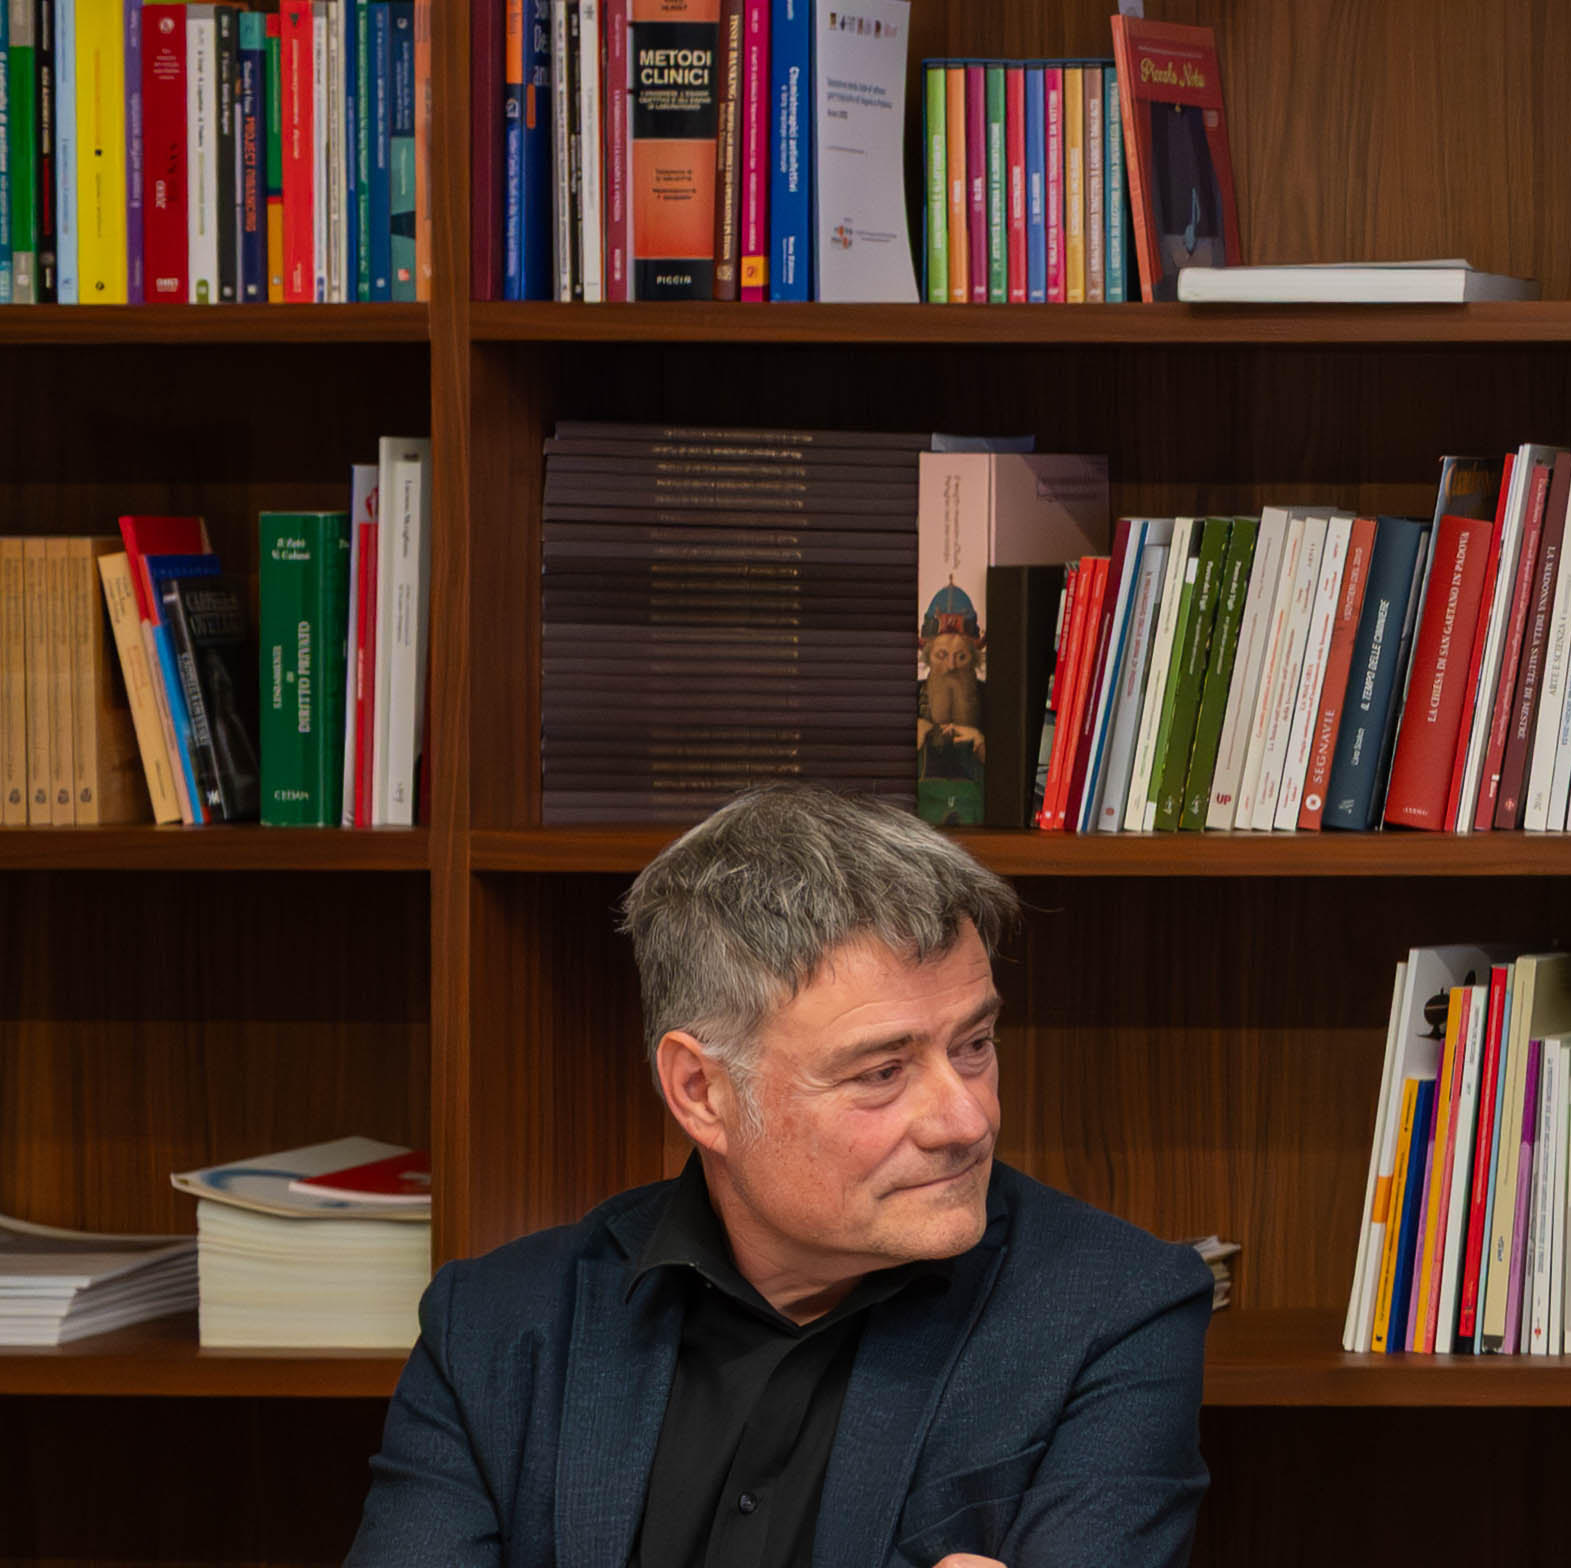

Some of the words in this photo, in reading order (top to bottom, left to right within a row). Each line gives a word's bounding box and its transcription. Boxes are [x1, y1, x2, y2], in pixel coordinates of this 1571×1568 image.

[640, 50, 711, 67] METODI
[641, 68, 708, 84] CLINICI
[1547, 546, 1556, 559] LA
[1536, 561, 1554, 612] MADONNA
[1532, 614, 1546, 646] DELLA
[1525, 648, 1541, 684] SALUTE
[298, 679, 310, 732] DIRITTO
[1516, 701, 1532, 739] MESTRE
